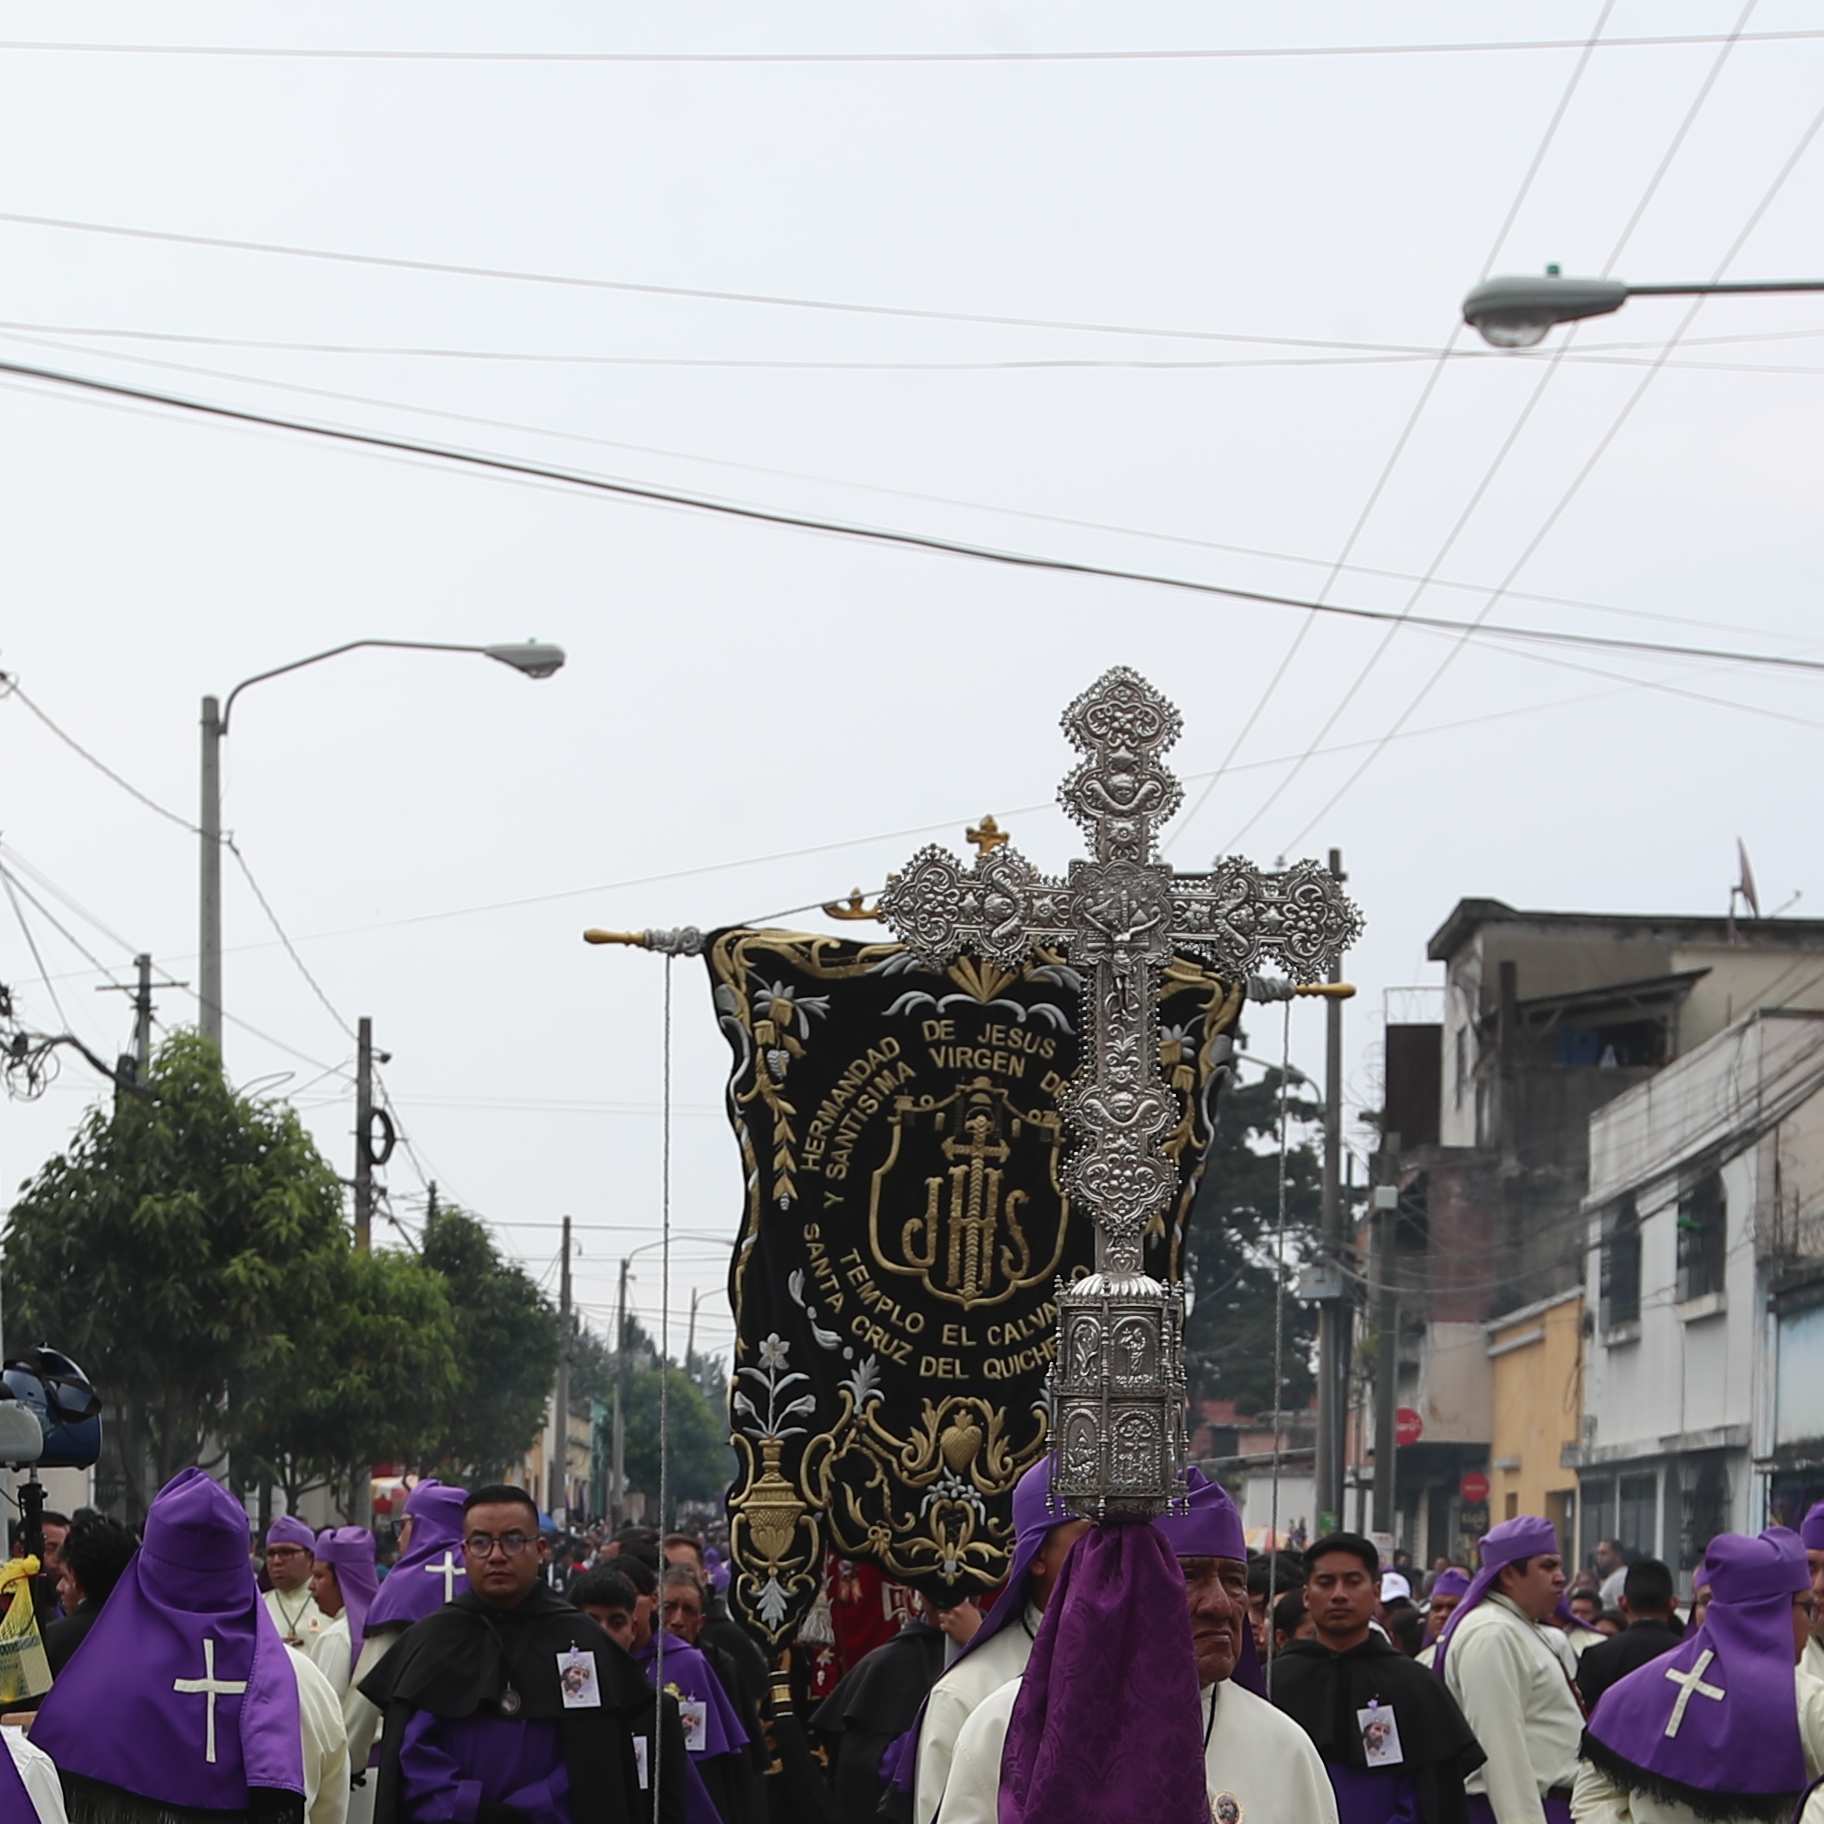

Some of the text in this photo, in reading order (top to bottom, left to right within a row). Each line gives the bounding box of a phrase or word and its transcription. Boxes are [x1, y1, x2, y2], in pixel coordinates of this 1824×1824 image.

[800, 1019, 1056, 1171] HERMANDAD DE JESUS
[928, 1046, 1026, 1078] VIRGEN
[826, 1061, 916, 1180] SANTISIMA
[823, 1191, 844, 1208] Y
[803, 1222, 845, 1314] SANTA
[850, 1315, 914, 1365] CRUZ
[919, 1355, 969, 1379] DEL
[840, 1248, 925, 1334] TEMPLO
[942, 1324, 977, 1346] EL
